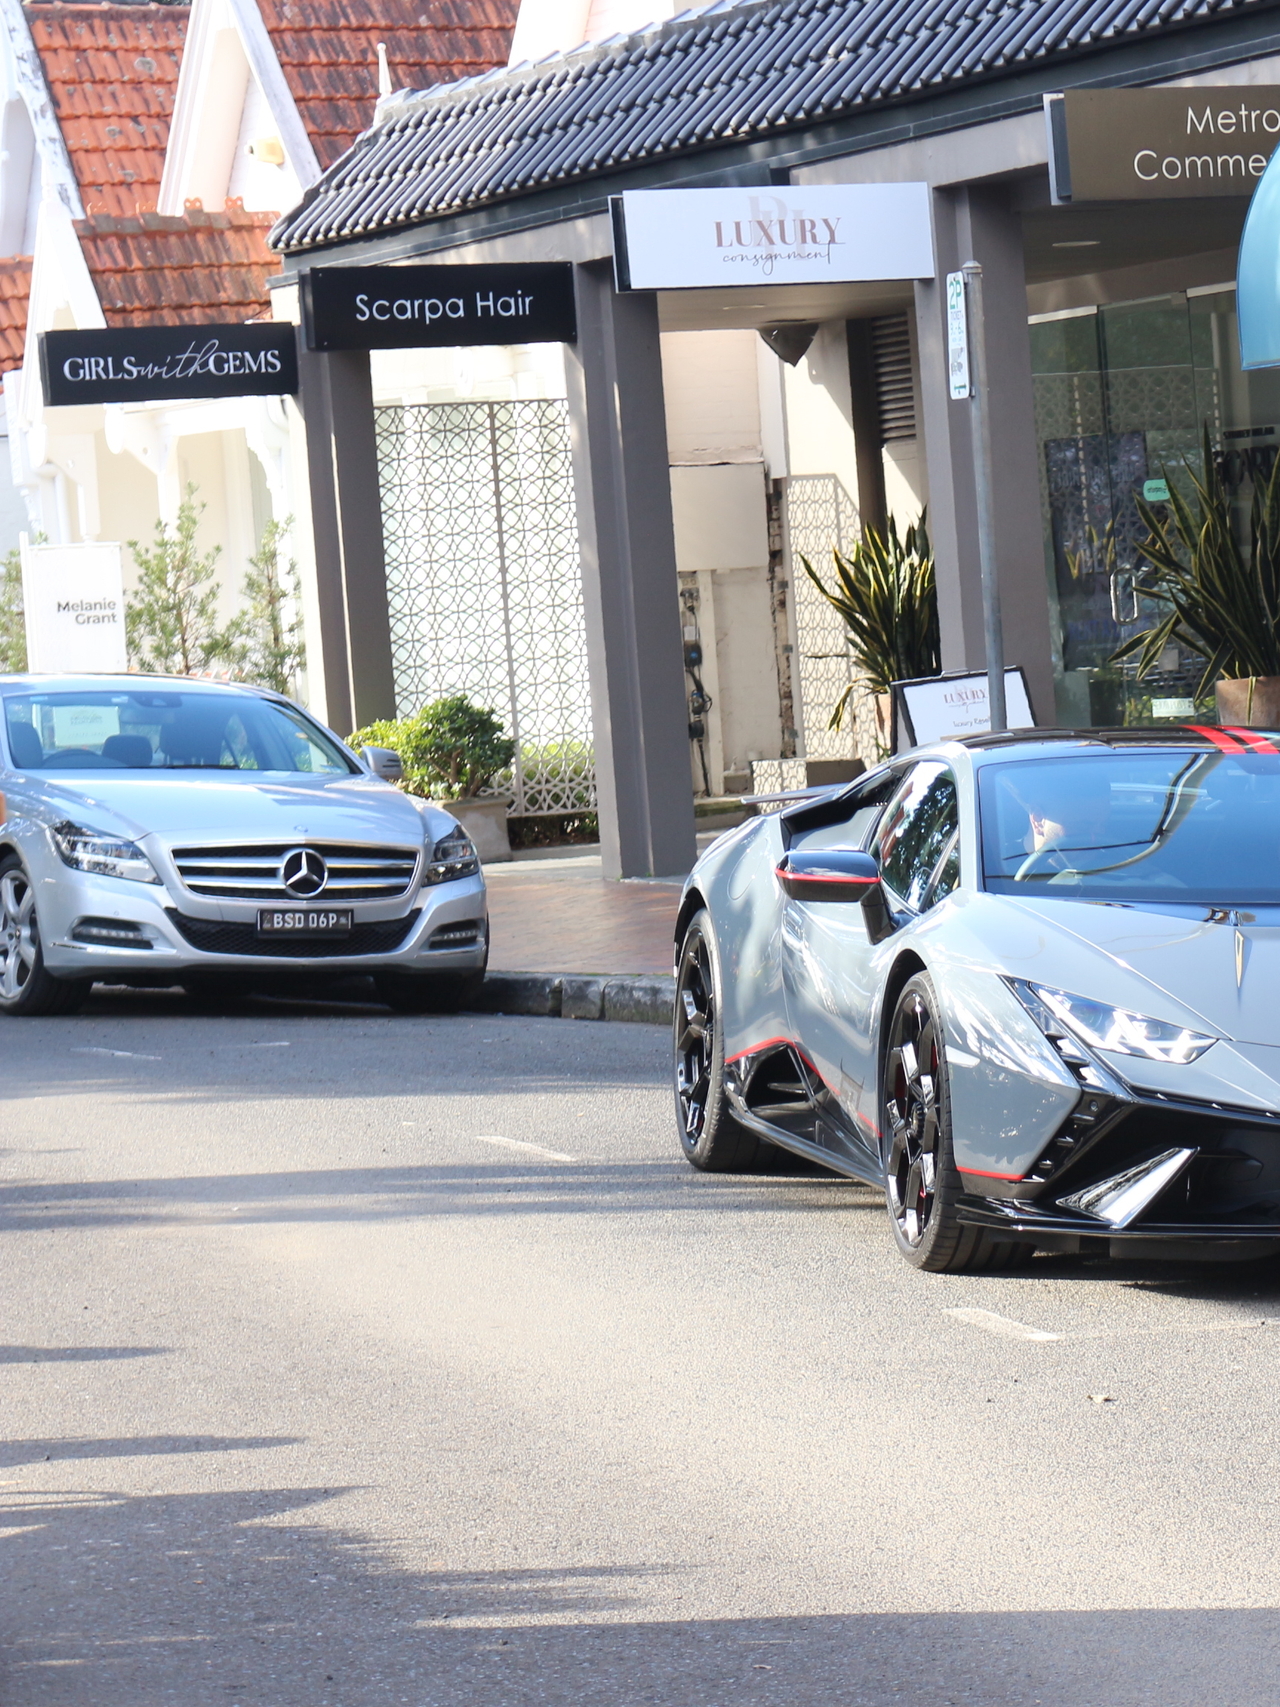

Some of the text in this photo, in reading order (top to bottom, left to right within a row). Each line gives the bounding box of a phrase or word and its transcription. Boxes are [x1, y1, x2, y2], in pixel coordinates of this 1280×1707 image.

[1187, 103, 1280, 134] Metro
[1134, 150, 1273, 180] Comme
[714, 217, 846, 248] LUXURY
[722, 239, 831, 276] consignment
[355, 290, 533, 324] Scarpa Hair
[57, 597, 116, 613] Melanie
[75, 612, 117, 625] Grant
[944, 688, 988, 704] LUXURY
